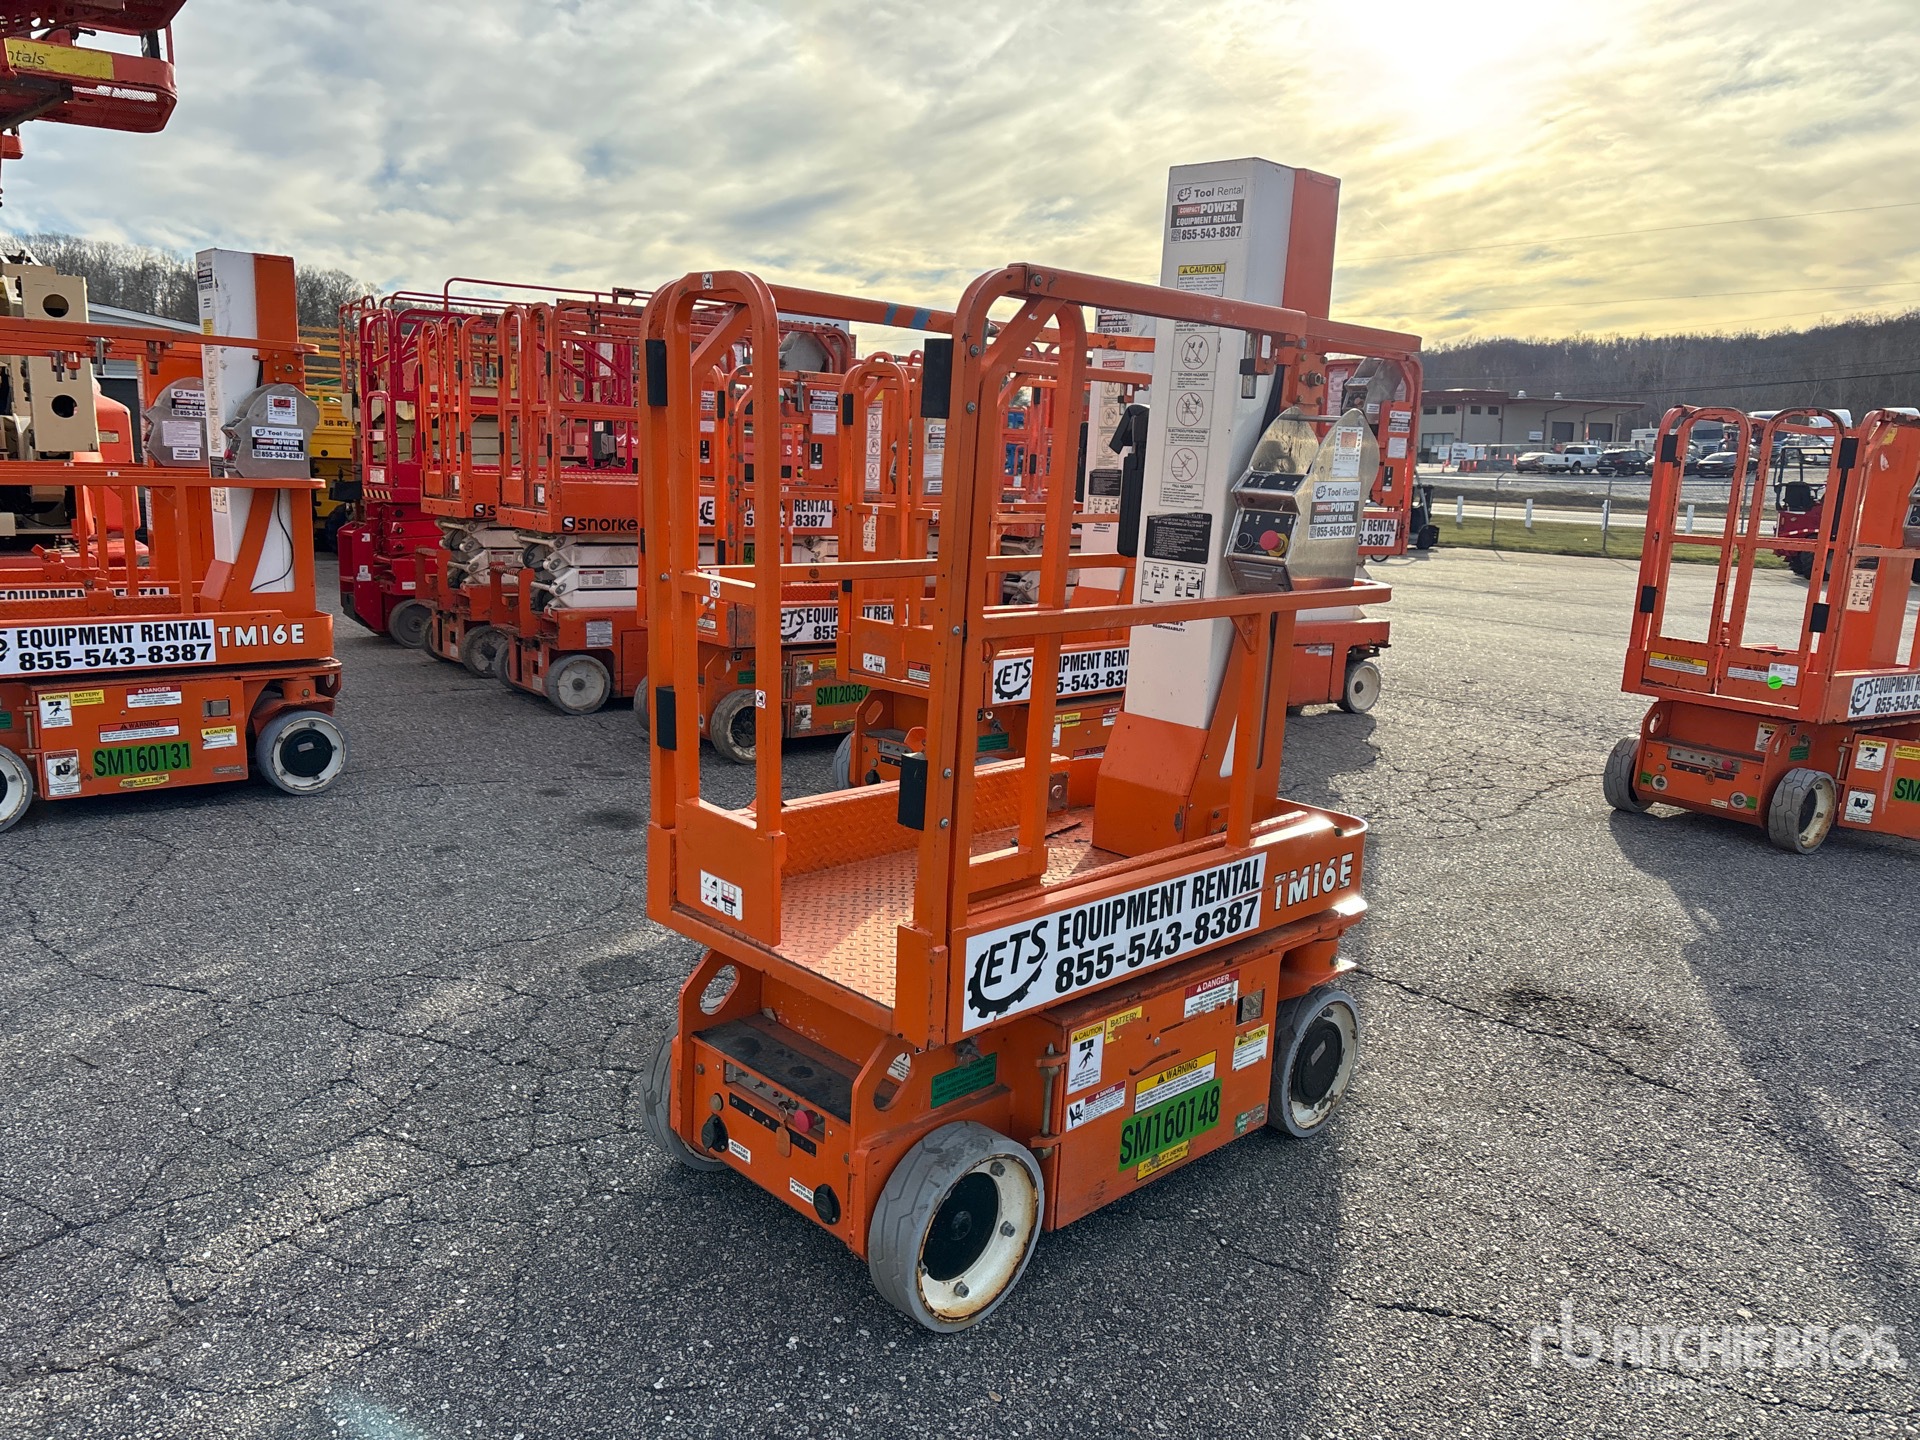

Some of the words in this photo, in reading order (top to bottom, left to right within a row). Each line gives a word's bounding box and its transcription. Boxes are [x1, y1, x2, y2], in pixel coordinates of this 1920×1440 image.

[1194, 188, 1214, 198] Tool
[1217, 185, 1243, 196] Rental
[1200, 201, 1238, 214] POWER
[1176, 216, 1212, 226] EQUIPMENT
[1213, 214, 1236, 223] RENTAL
[1182, 226, 1241, 240] 855-543-8387
[1328, 488, 1341, 496] Tool
[794, 499, 831, 513] RENTAL
[1331, 503, 1354, 512] POWER
[1314, 515, 1338, 523] EQUIPMENT
[1367, 520, 1395, 532] RENTAL
[1317, 525, 1355, 537] 855-543-8387
[17, 625, 133, 649] EQUIPMENT
[141, 622, 211, 642] RENTAL
[218, 623, 305, 647] TM16E
[19, 643, 212, 671] 855-543-8387
[1003, 659, 1031, 686] ETS
[1856, 679, 1875, 702] ETS
[1874, 676, 1915, 695] EQUIPMENT
[129, 720, 160, 728] WARNING
[94, 743, 190, 777] SM160131
[1274, 852, 1354, 911] TM16E
[984, 920, 1048, 988] ETS
[1057, 880, 1186, 952] EQUIPMENT
[1191, 859, 1260, 909] RENTAL
[1055, 896, 1258, 993] 855-543-8387
[1203, 974, 1230, 990] DANGER
[1110, 1012, 1138, 1028] BATTERY
[1078, 1025, 1103, 1040] CAUTION
[1166, 1060, 1198, 1080] WARNING
[1100, 1086, 1116, 1096] DANGER
[1120, 1086, 1219, 1164] SM160148
[731, 1140, 749, 1155] BATTERY
[791, 1180, 806, 1191] POWER
[806, 1188, 813, 1196] TO
